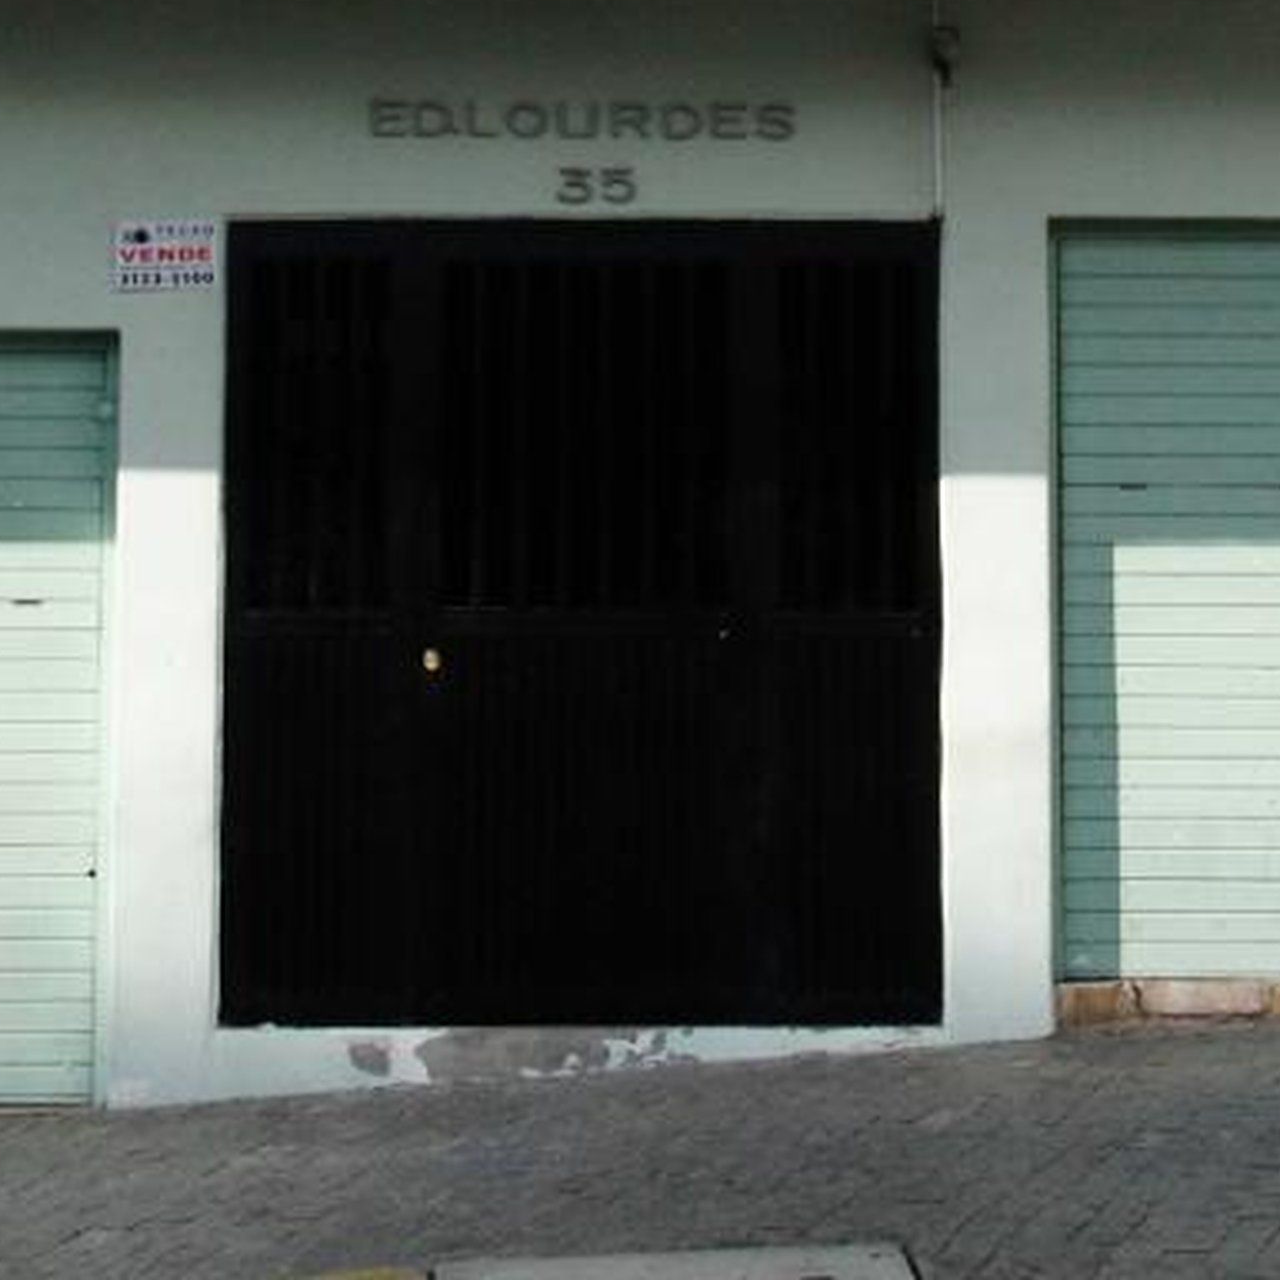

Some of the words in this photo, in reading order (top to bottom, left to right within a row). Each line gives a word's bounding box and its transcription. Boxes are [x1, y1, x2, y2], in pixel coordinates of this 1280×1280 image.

[468, 100, 797, 140] LOURDES
[556, 167, 638, 205] 35
[119, 245, 213, 262] VENDE
